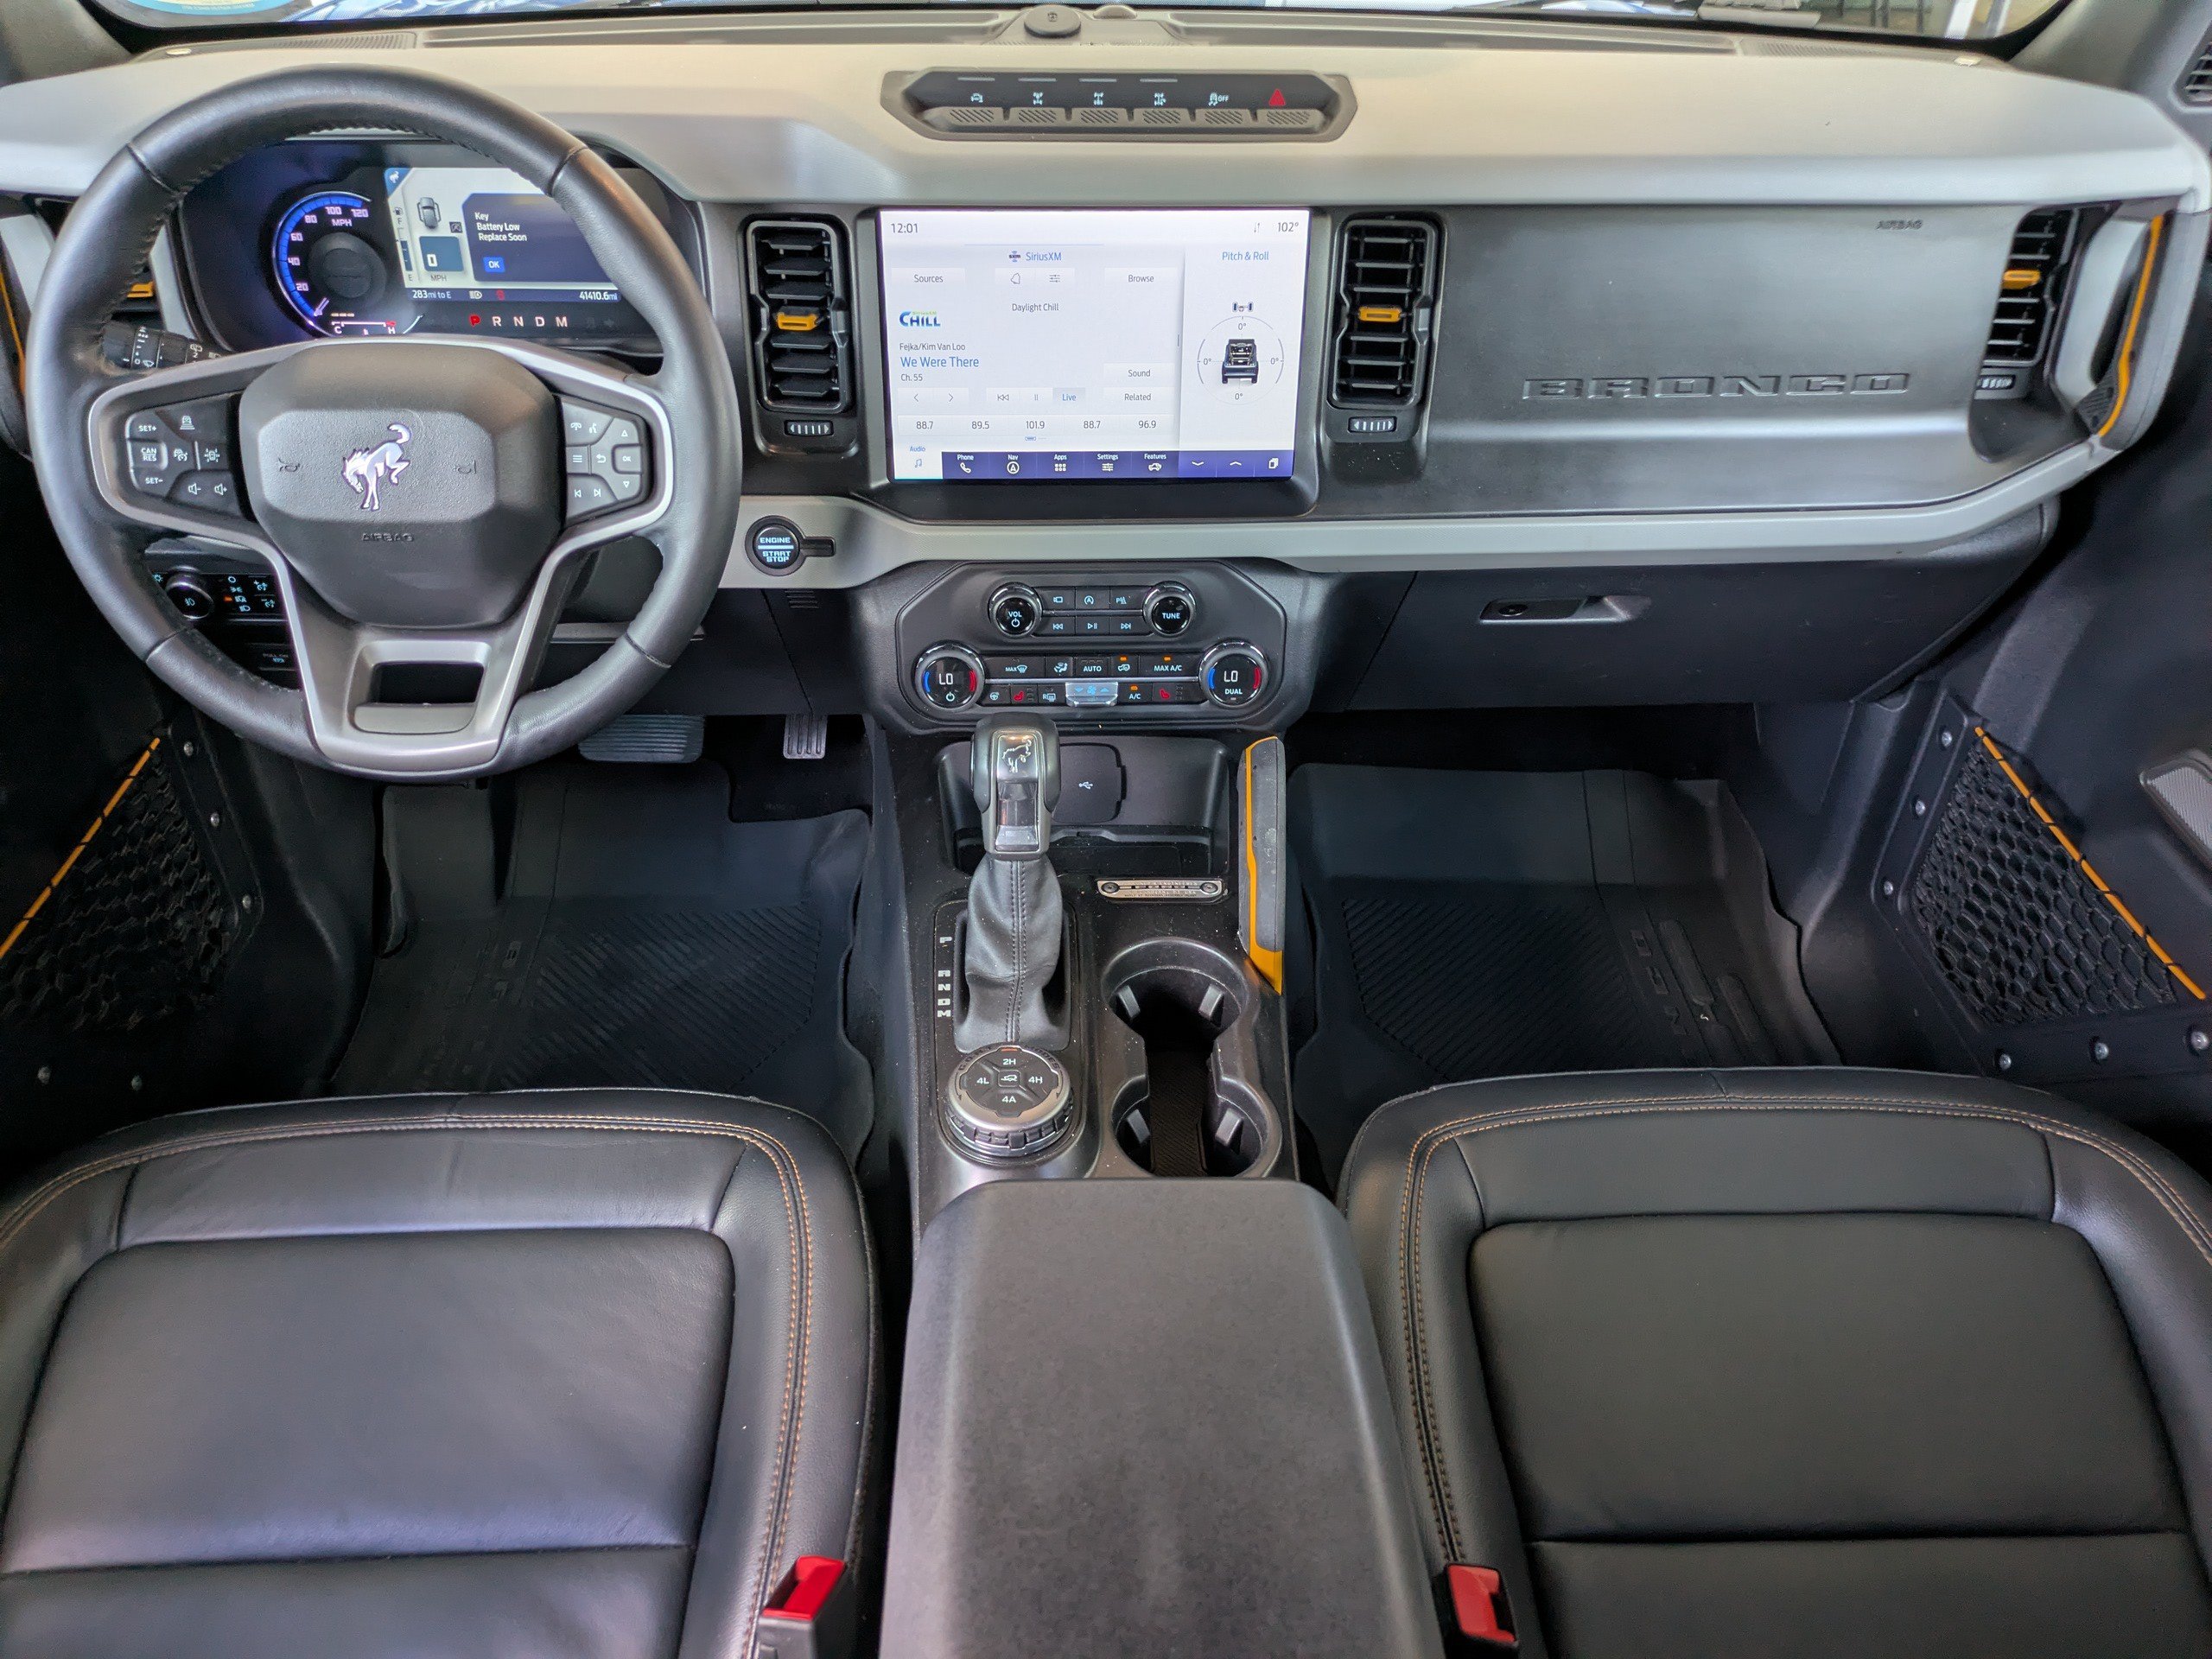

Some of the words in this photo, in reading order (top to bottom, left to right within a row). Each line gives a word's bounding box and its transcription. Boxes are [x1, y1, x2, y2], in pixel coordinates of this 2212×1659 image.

[325, 207, 341, 215] 100
[351, 208, 369, 218] 120
[305, 214, 317, 223] 80
[475, 212, 489, 222] Key
[477, 222, 504, 232] Battery
[505, 222, 520, 232] Low
[890, 223, 918, 233] 12:01
[1277, 222, 1300, 232] 102°
[1875, 219, 1923, 230] AIRBAG
[290, 232, 303, 241] 60
[479, 232, 507, 243] Replace
[508, 233, 527, 242] Soon
[1025, 251, 1062, 261] SiriusXM
[1222, 251, 1243, 261] Pitch
[1253, 251, 1269, 260] Roll
[288, 257, 301, 266] 40
[913, 275, 944, 283] Sources
[296, 283, 308, 292] 20
[1012, 302, 1041, 313] Daylight
[1043, 302, 1059, 312] Chill
[469, 315, 480, 327] P
[492, 316, 502, 327] R
[513, 316, 524, 327] N
[535, 316, 545, 327] D
[556, 316, 569, 327] M
[899, 311, 941, 327] CHILL
[388, 326, 396, 334] H
[899, 342, 936, 352] Fejka/Kim
[937, 342, 951, 351] Van
[952, 342, 966, 351] Loo
[900, 357, 917, 367] We
[919, 357, 947, 367] Were
[949, 357, 980, 367] There
[900, 373, 912, 382] Ch.
[913, 373, 923, 382] 55
[1128, 369, 1151, 378] Sound
[1522, 372, 1910, 400] BRONCO
[1124, 393, 1152, 402] Related
[916, 421, 934, 429] 88.7
[971, 421, 990, 429] 89.5
[1026, 420, 1045, 429] 101.9
[1084, 420, 1101, 429] 88.7
[1138, 420, 1157, 429] 96.9
[1054, 454, 1067, 462] Apps
[938, 673, 954, 685] LO
[1224, 671, 1238, 683] LO
[1028, 1076, 1043, 1084] 4H
